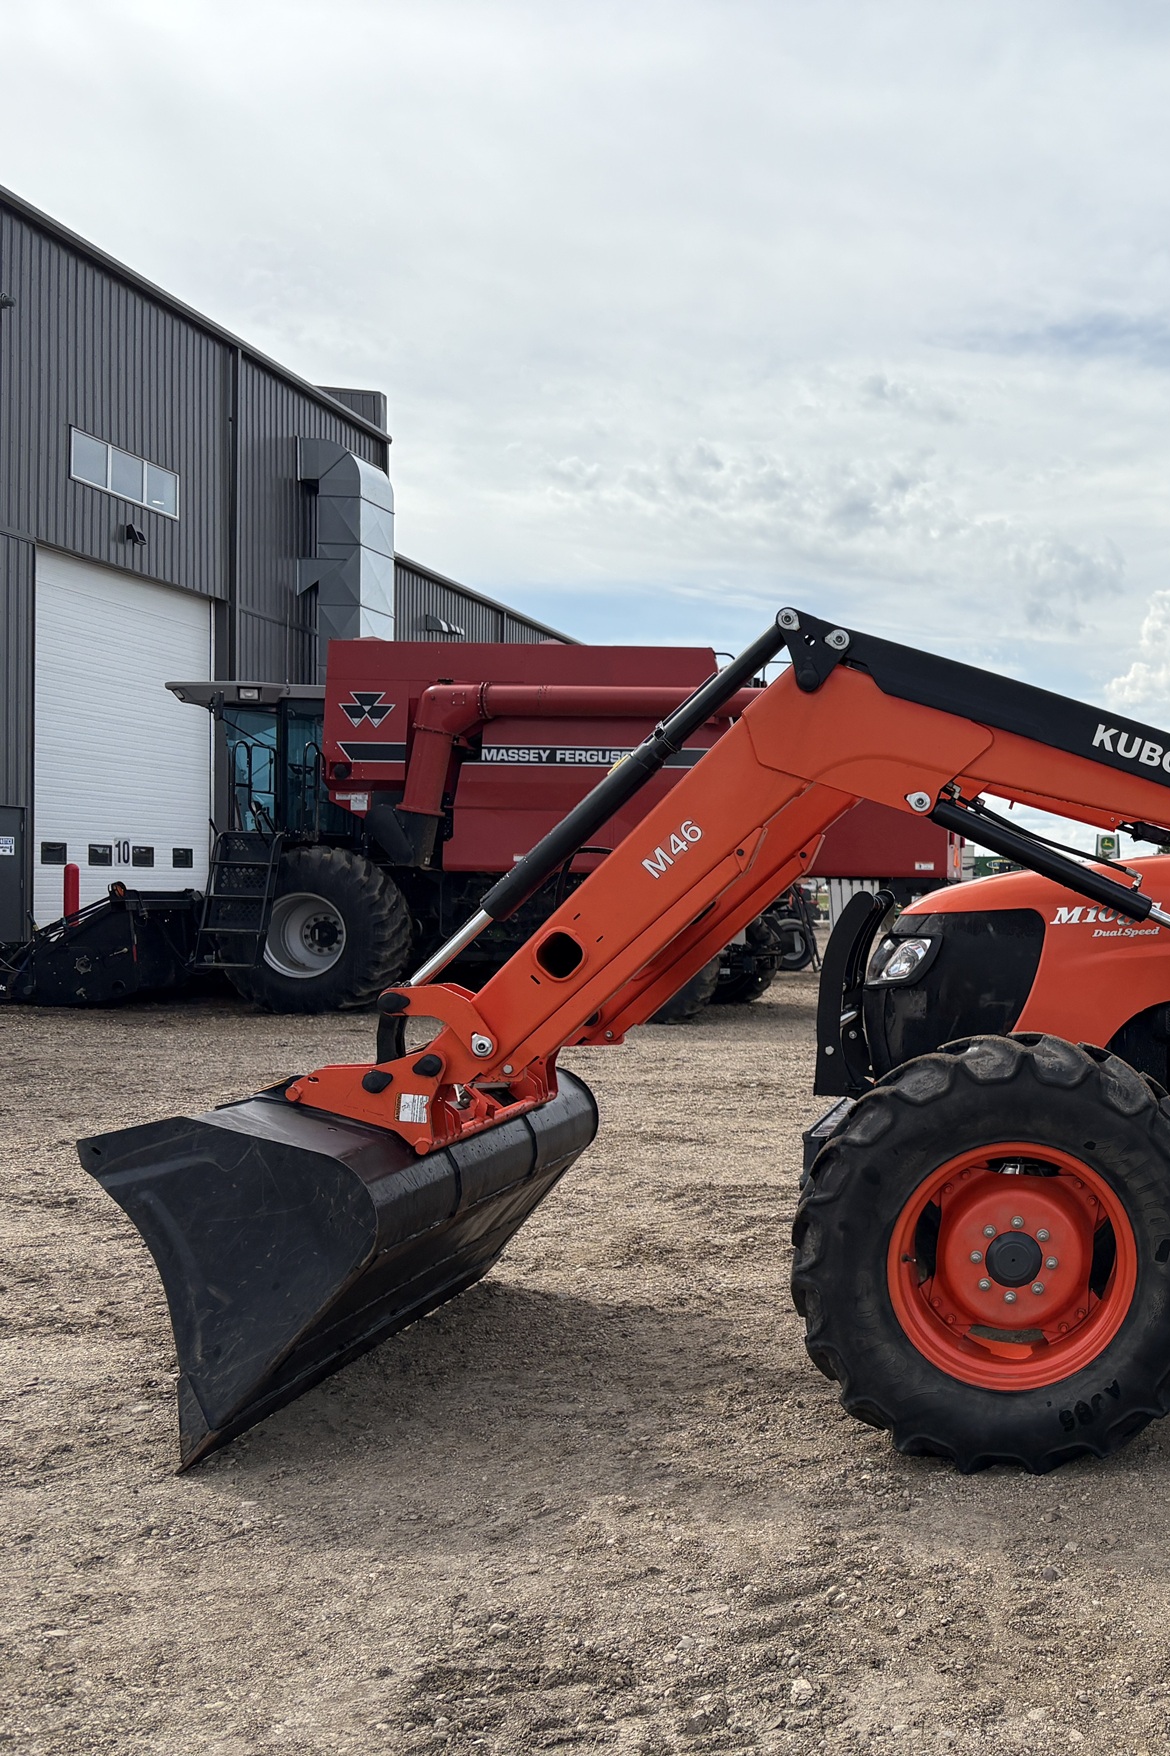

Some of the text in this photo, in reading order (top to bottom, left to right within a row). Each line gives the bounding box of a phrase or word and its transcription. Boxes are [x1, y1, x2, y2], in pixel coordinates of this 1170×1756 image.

[481, 748, 550, 761] MASSEY
[115, 840, 130, 864] 10
[641, 820, 703, 879] M46
[1049, 902, 1162, 926] M10
